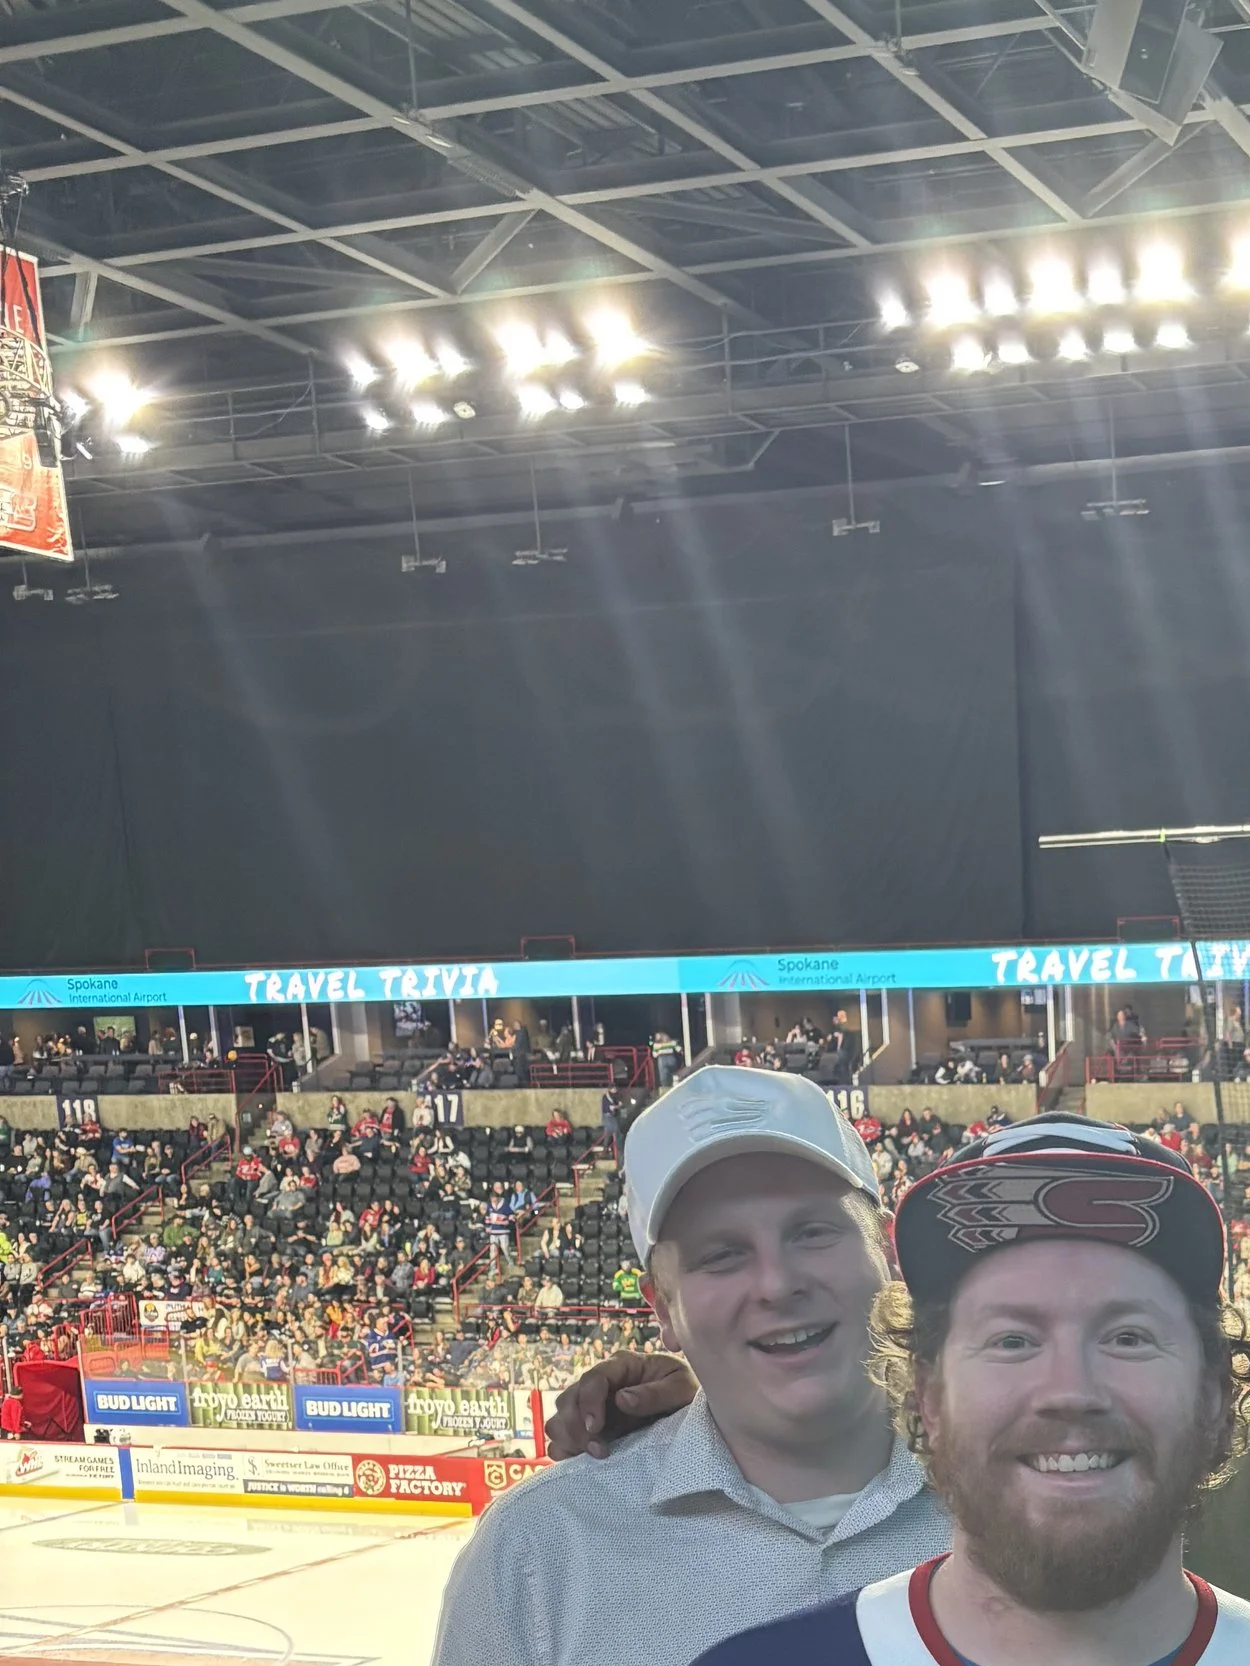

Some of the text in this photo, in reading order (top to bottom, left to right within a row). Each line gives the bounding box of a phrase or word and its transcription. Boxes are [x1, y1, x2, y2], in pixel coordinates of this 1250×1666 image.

[777, 956, 839, 973] Spokane
[991, 947, 1137, 984] TRAVEL
[67, 977, 119, 992] Spokane
[244, 964, 499, 1004] TRAVEL TRIVIA
[778, 973, 896, 985] International Airport
[69, 991, 168, 1004] International Airport
[96, 1394, 177, 1411] BUD LIGHT
[192, 1387, 289, 1422] froyo earth
[305, 1400, 391, 1418] BUD LIGHT
[407, 1393, 509, 1429] froyo earth
[136, 1458, 176, 1475] Inland
[304, 1460, 320, 1470] Law
[323, 1461, 350, 1471] Office
[388, 1464, 436, 1480] PIZZA
[389, 1479, 465, 1497] FACTORY
